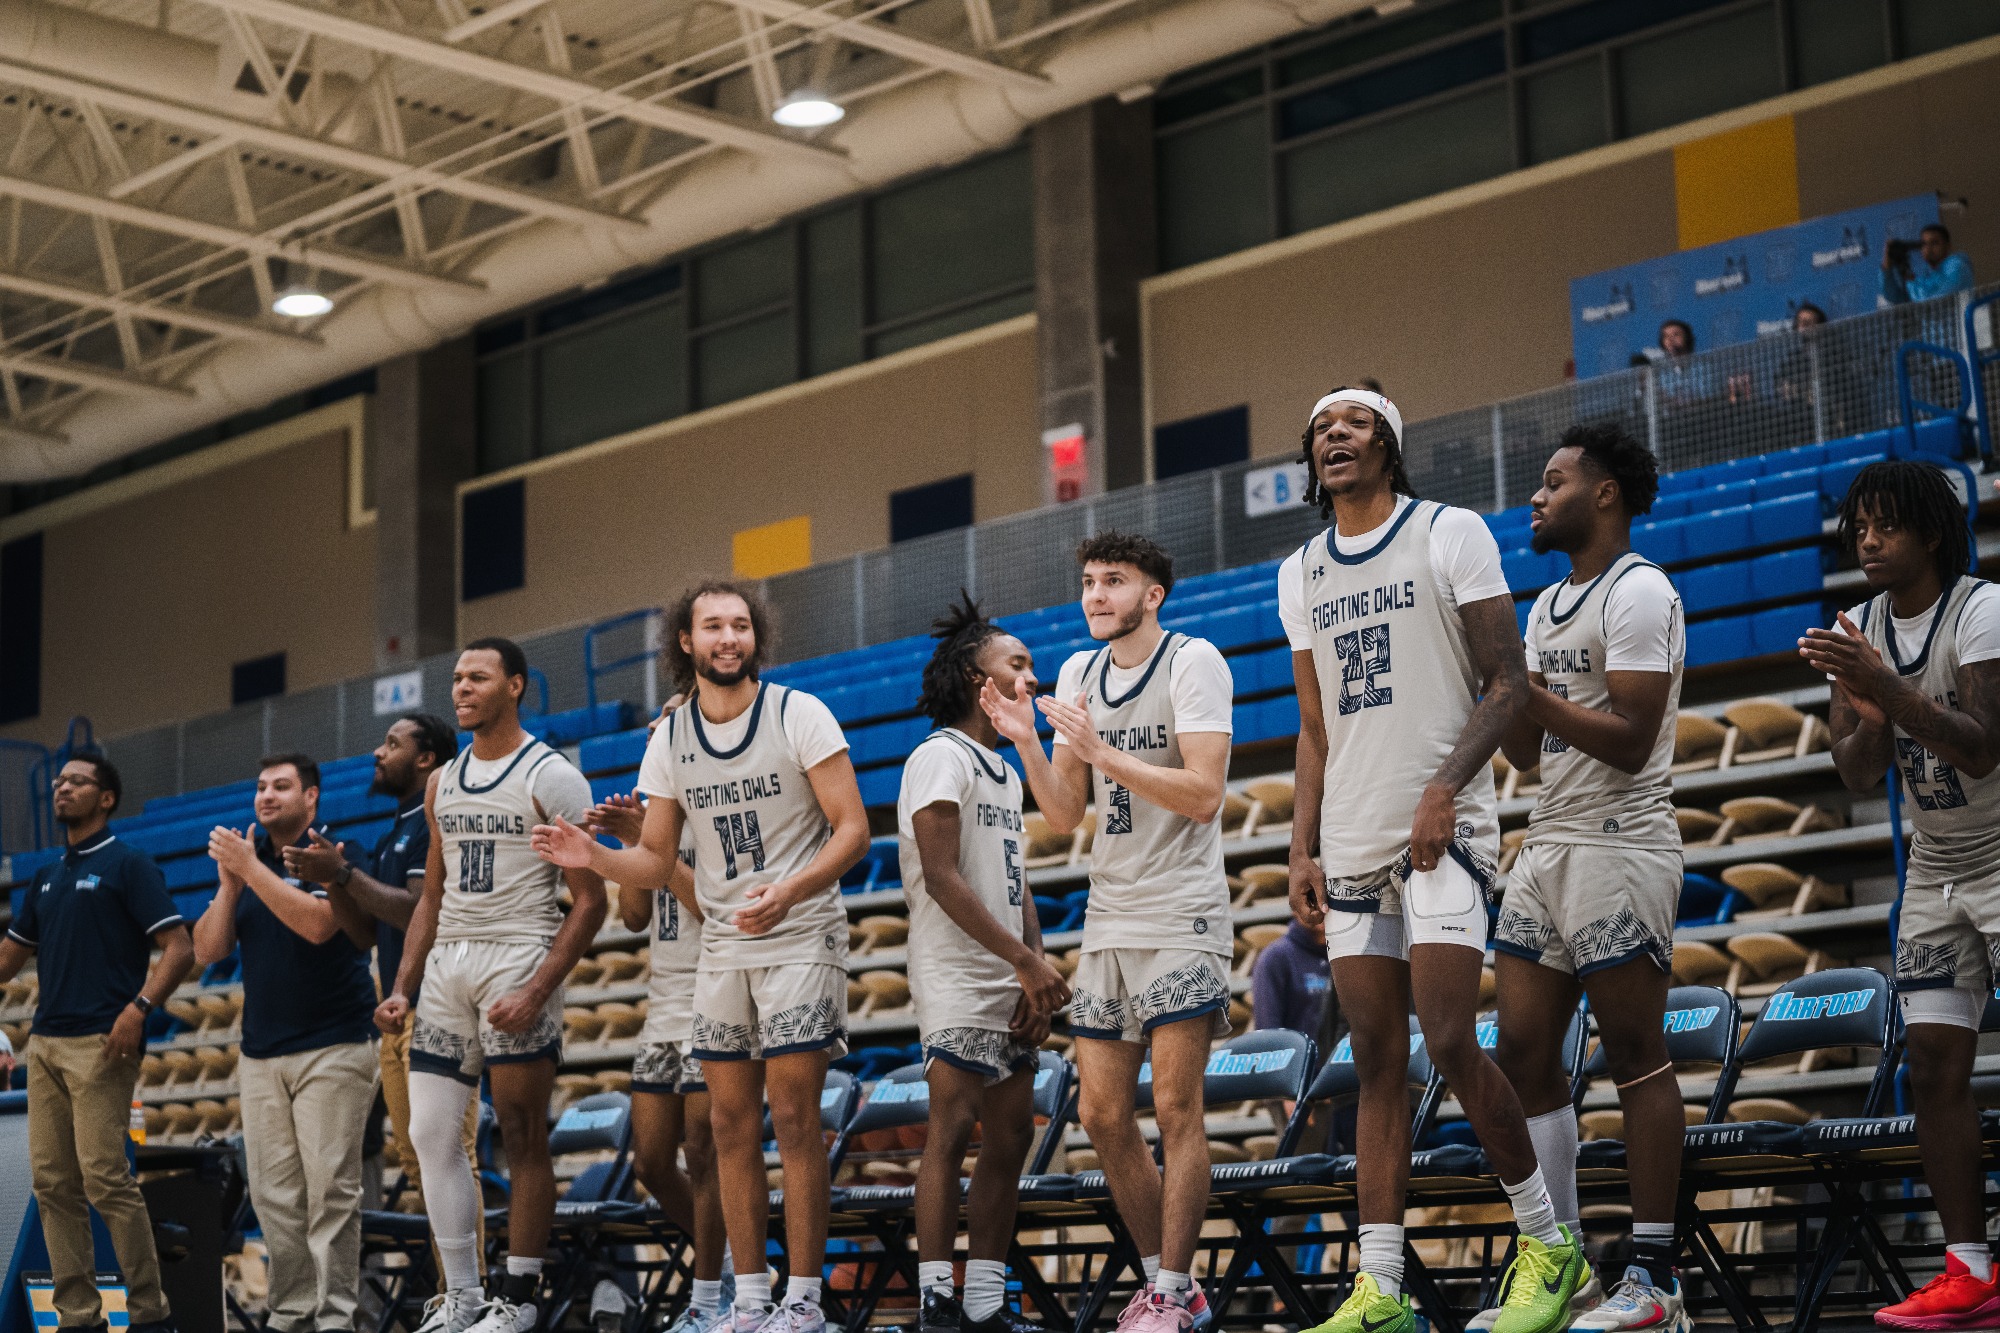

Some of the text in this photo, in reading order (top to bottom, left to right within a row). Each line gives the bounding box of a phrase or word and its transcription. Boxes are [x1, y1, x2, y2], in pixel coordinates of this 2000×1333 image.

[1312, 580, 1415, 633] FIGHTING OWLS
[1333, 622, 1393, 716] 22
[1560, 648, 1592, 673] OWLS
[1128, 724, 1168, 750] OWLS
[685, 772, 782, 810] FIGHTING OWLS
[1895, 737, 1969, 812] 23
[486, 814, 525, 835] OWLS
[977, 802, 1012, 831] FIGHTING
[712, 809, 766, 881] 14
[458, 839, 496, 893] 10
[1003, 838, 1022, 907] 5
[1763, 988, 1876, 1022] HARFORD
[1203, 1048, 1297, 1076] HARFORD
[1711, 1129, 1745, 1145] OWLS
[1818, 1119, 1915, 1140] FIGHTING OWL
